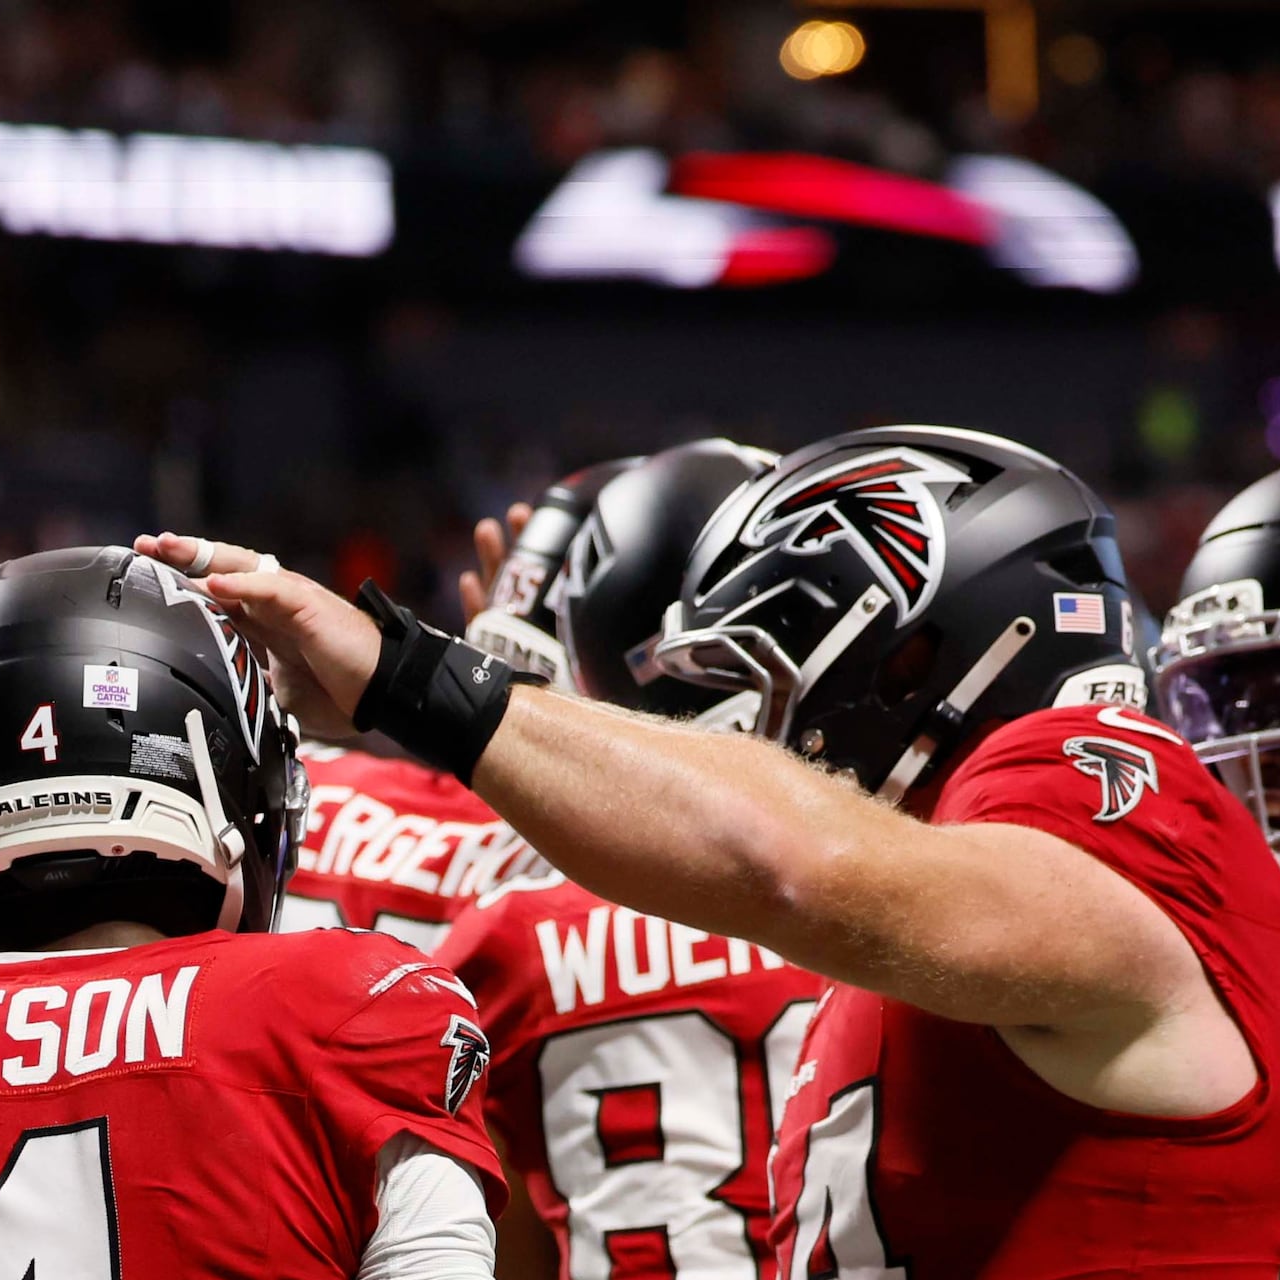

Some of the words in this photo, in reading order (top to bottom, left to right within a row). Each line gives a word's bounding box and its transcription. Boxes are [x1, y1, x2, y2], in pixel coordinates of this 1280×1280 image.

[92, 684, 131, 695] CRUCIAL
[97, 693, 126, 702] CATCH
[1088, 681, 1141, 705] FAL
[19, 702, 60, 763] 4
